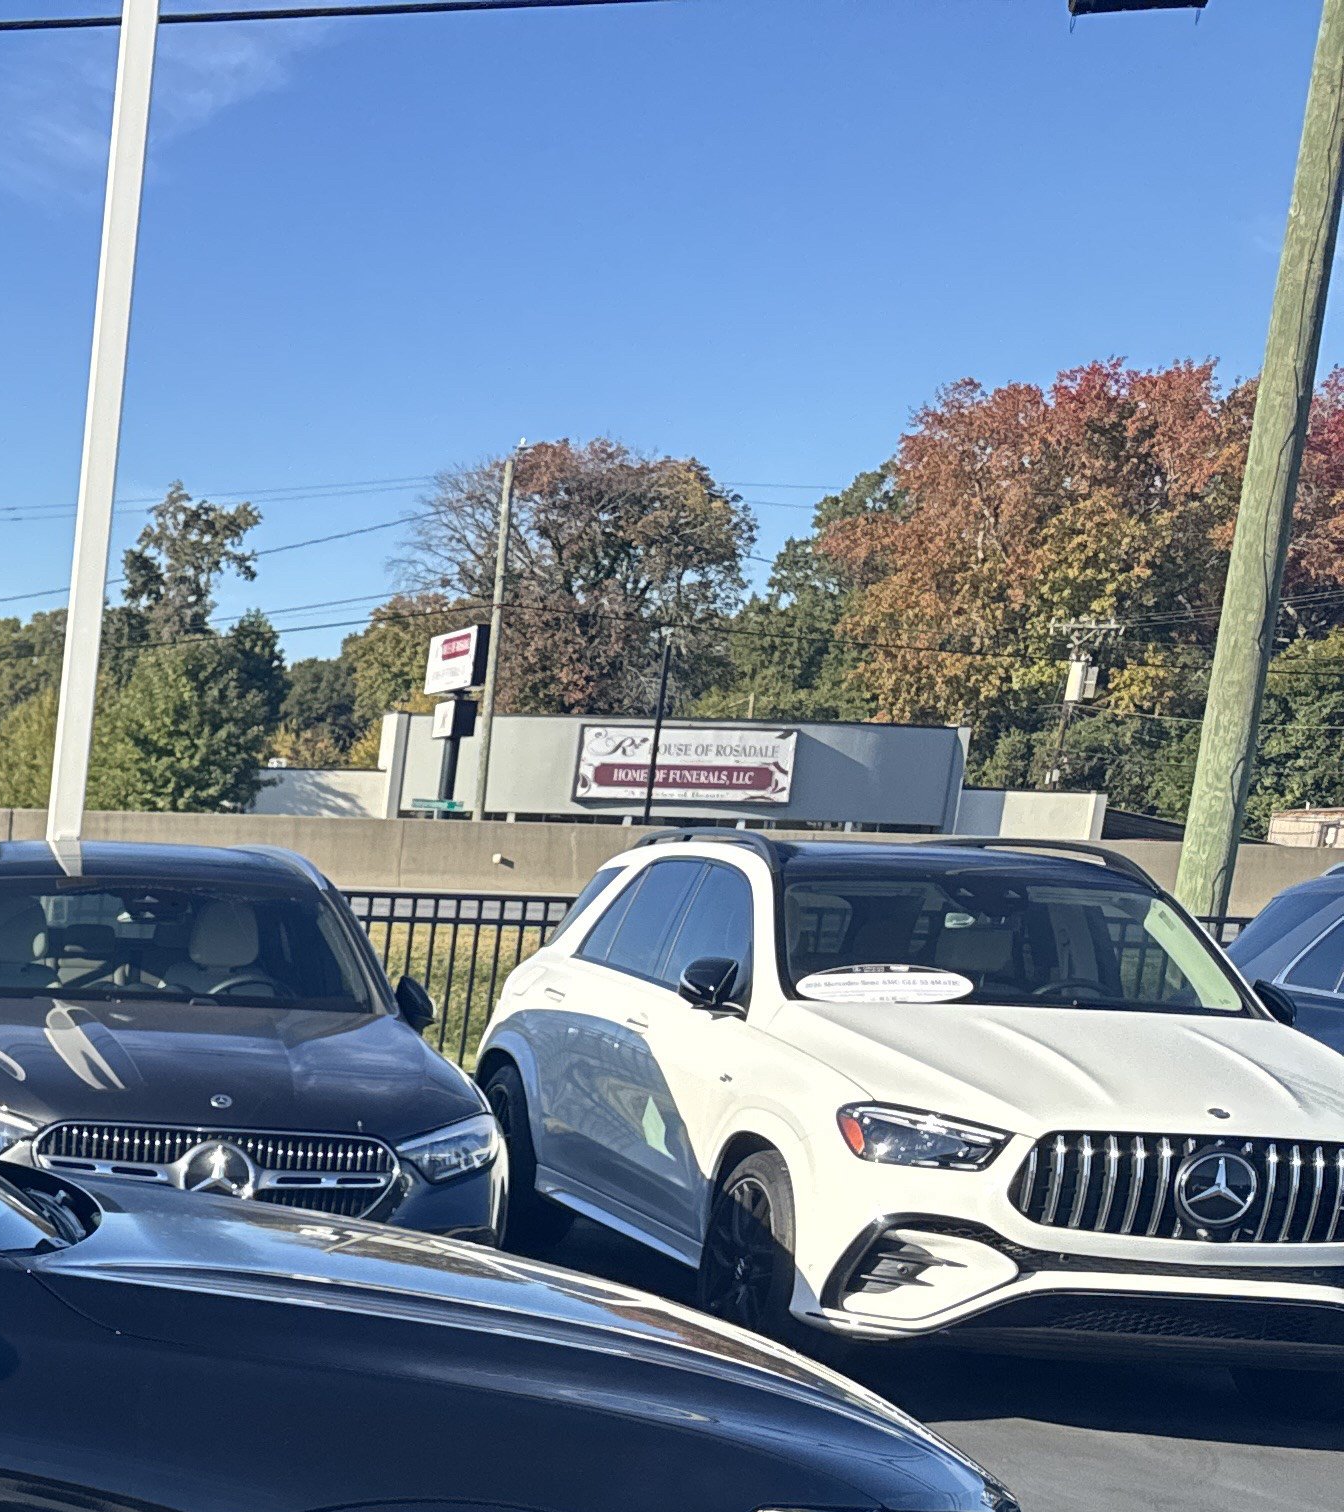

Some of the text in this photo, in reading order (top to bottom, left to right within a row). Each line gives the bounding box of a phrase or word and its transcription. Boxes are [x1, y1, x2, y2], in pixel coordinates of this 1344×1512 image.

[694, 743, 714, 757] OF
[715, 744, 780, 759] ROSADALE
[612, 767, 649, 783] HOME
[668, 769, 731, 785] FUNERALS,
[732, 771, 756, 785] LLC
